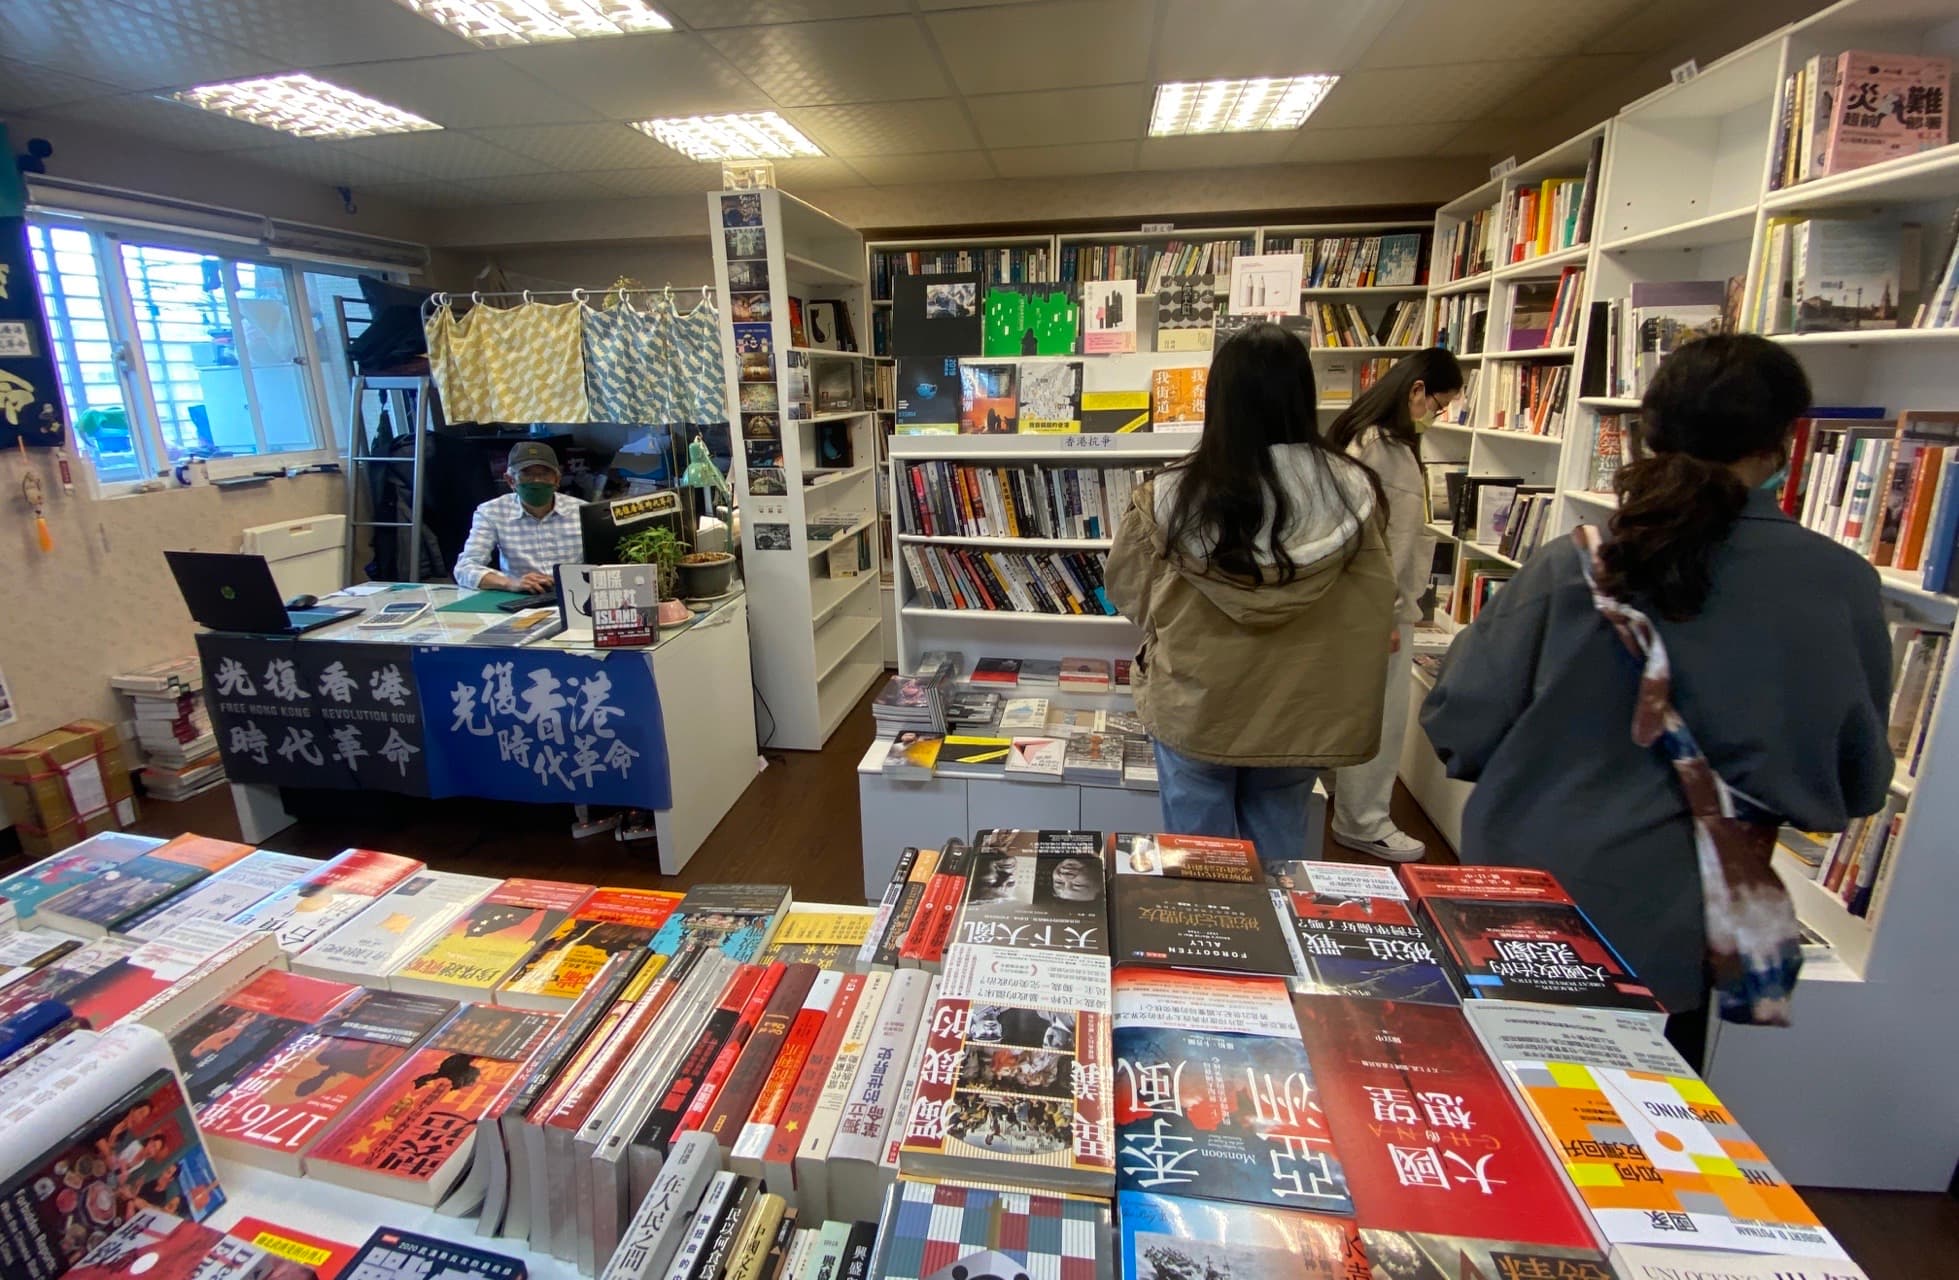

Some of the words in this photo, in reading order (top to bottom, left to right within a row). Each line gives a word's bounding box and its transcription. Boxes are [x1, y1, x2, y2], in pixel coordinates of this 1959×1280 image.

[594, 608, 638, 626] ISLAND
[214, 657, 412, 706] 光復香港
[219, 702, 248, 715] FREE
[249, 704, 278, 717] HONG
[280, 706, 311, 719] KONG
[321, 709, 388, 723] REVOLUTION
[391, 711, 416, 725] NOW
[450, 661, 625, 744] 光復香港
[228, 724, 421, 777] 時代革命
[499, 725, 640, 791] 時代革命
[963, 920, 1099, 950] 天下大亂
[1189, 940, 1221, 948] ALLY
[1302, 932, 1438, 965] 被迫一戰
[1168, 947, 1247, 959] FORGOTTEN
[1493, 940, 1578, 965] 悲劇
[1488, 960, 1611, 982] 大國政治的
[862, 1047, 893, 1104] 的世界史
[907, 1005, 972, 1139] 獨裁的
[842, 1102, 866, 1134] 獨立
[861, 1105, 884, 1138] 革命
[1070, 1060, 1113, 1159] 異義
[1118, 1057, 1199, 1188] 季風
[1362, 1085, 1477, 1130] 想望
[1643, 1101, 1727, 1125] UPSWING
[225, 1104, 328, 1147] 1776
[1247, 1067, 1347, 1200] 亞洲
[1425, 1130, 1441, 1143] 的
[1200, 1149, 1256, 1166] Monsoon
[1560, 1138, 1647, 1161] 反彈回升
[1387, 1143, 1508, 1195] 大國
[1614, 1163, 1664, 1184] 如何
[1737, 1167, 1779, 1188] THE
[619, 1174, 685, 1272] 在人民之間
[1643, 1212, 1698, 1234] 國家
[1734, 1226, 1777, 1240] PUTNAM
